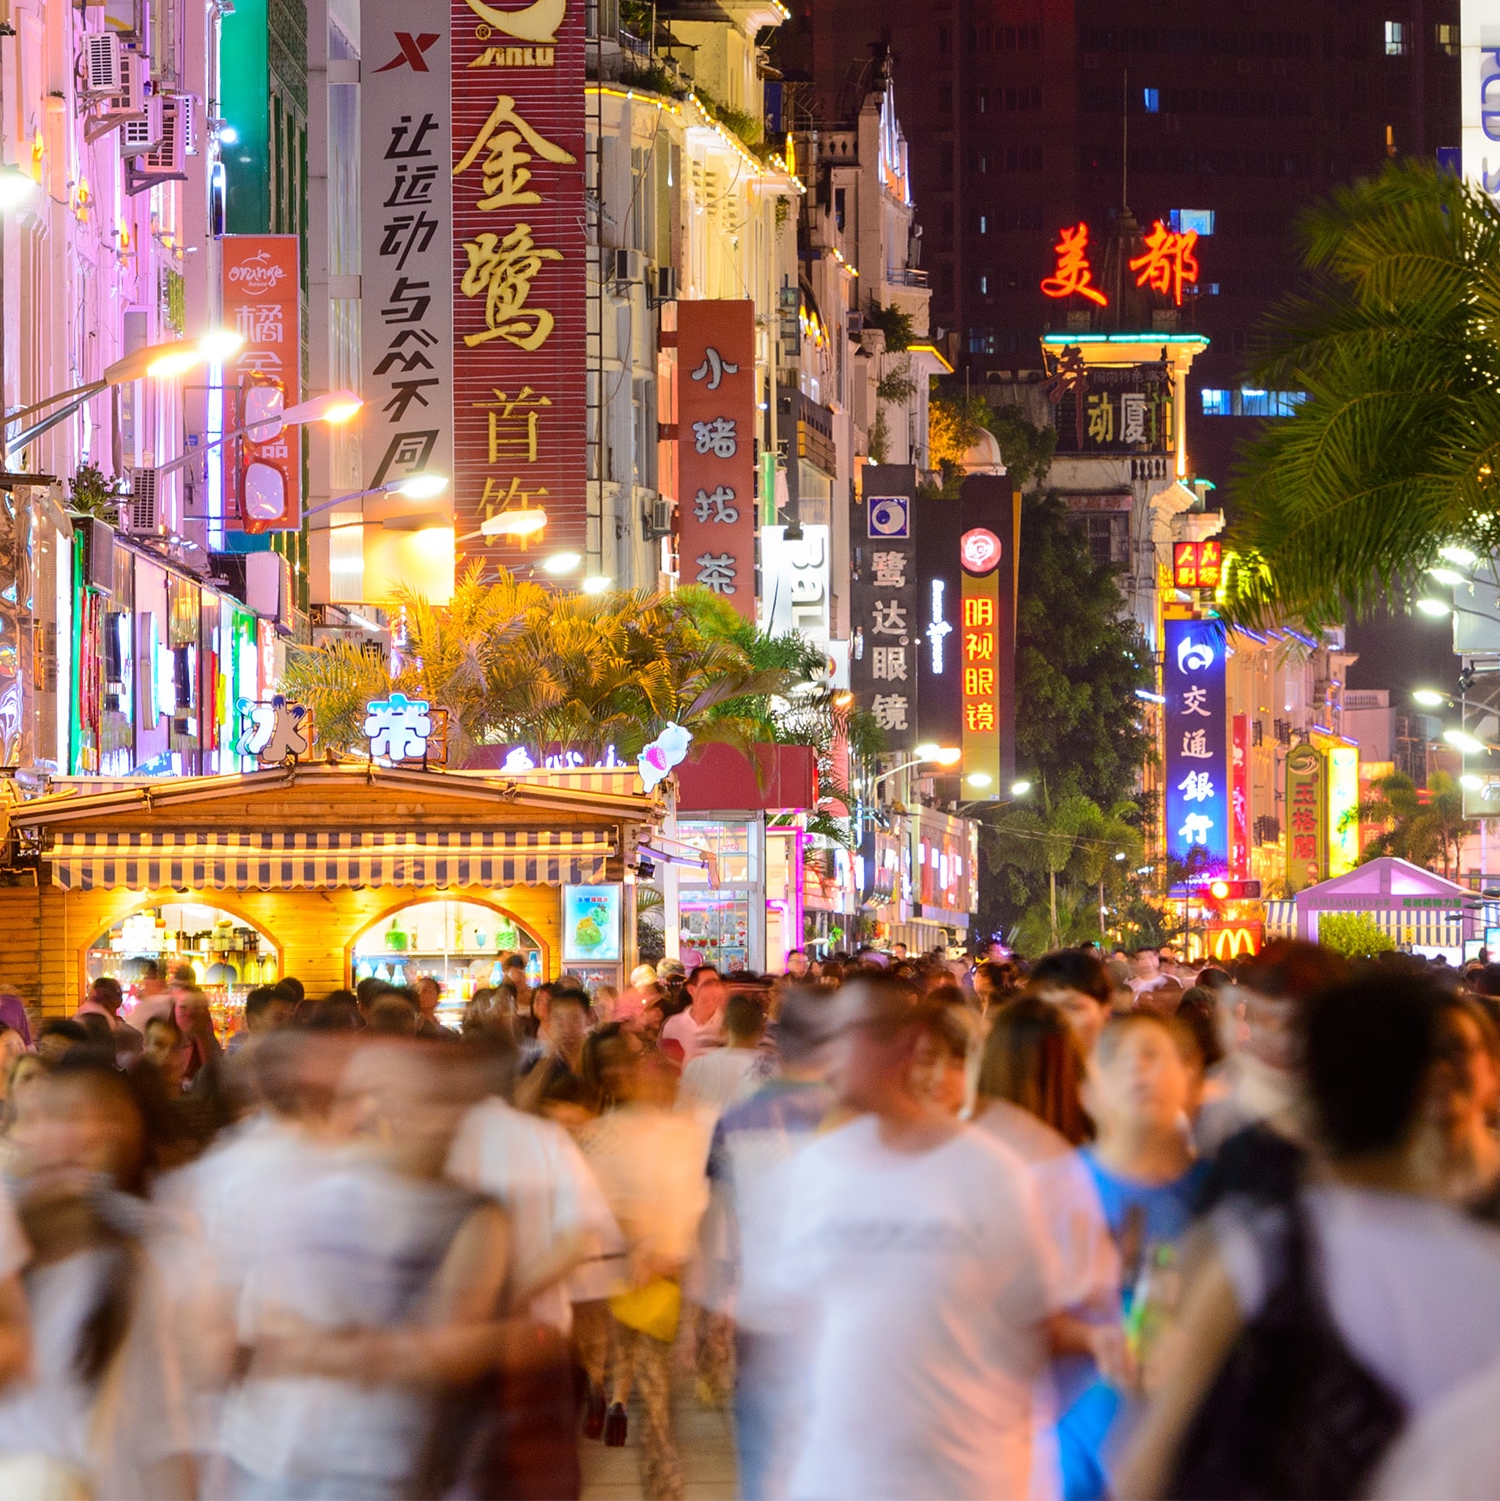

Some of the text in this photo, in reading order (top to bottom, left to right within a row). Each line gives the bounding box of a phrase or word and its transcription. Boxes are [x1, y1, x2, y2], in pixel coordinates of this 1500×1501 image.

[372, 113, 440, 490] 让运动与众不同
[1041, 221, 1199, 306] 美都
[871, 551, 909, 732] 鹭达眼镜
[965, 598, 994, 732] 明视眼镜
[1177, 685, 1215, 845] 交通銀行
